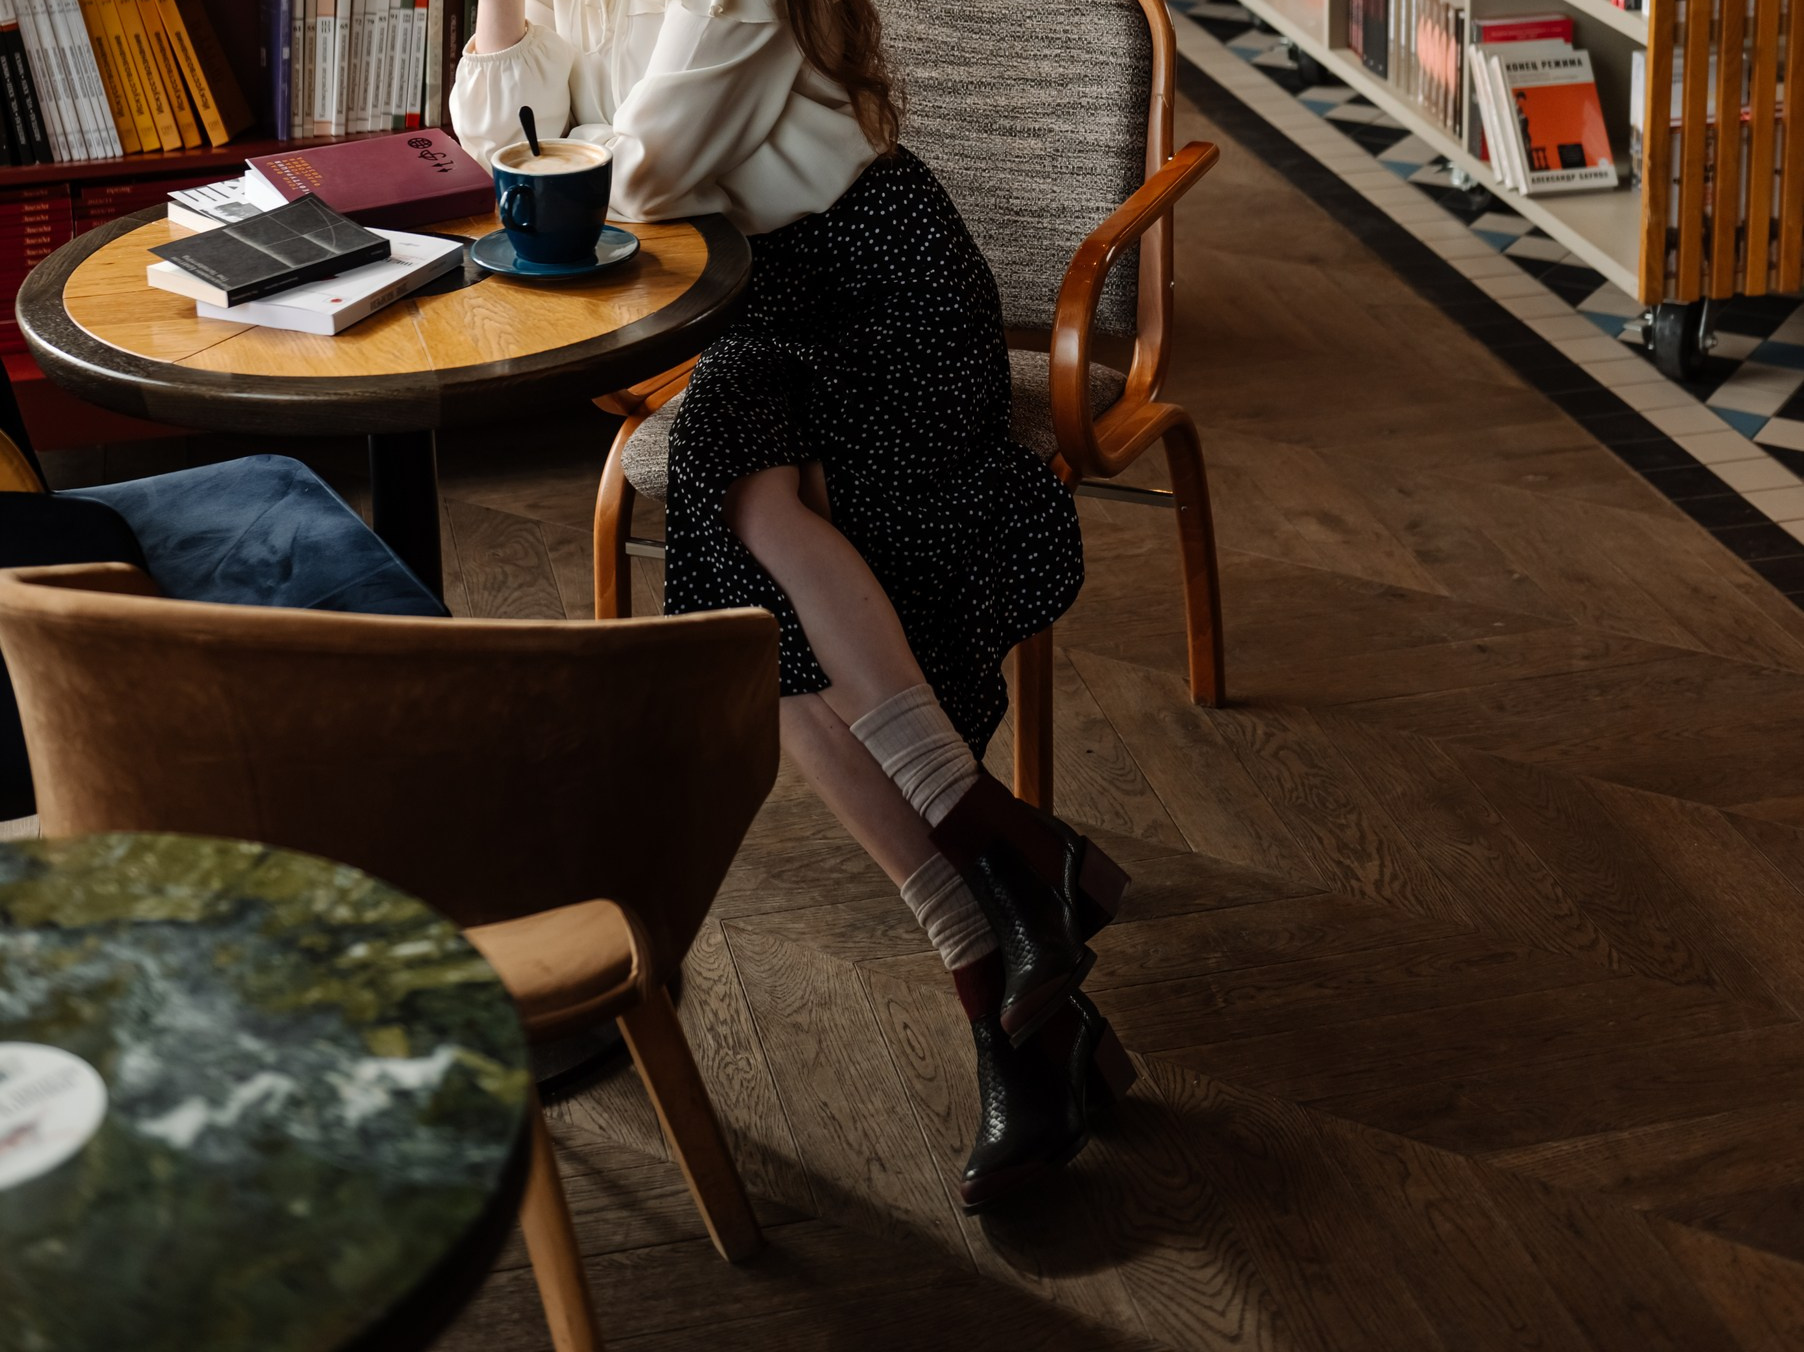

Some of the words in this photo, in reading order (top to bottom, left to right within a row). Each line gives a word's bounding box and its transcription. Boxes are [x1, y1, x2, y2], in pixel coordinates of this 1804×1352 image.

[1506, 59, 1538, 72] КОНЕЦ
[1541, 57, 1584, 69] РЕЖИМА
[1531, 173, 1576, 185] АЛЕКСАНДР
